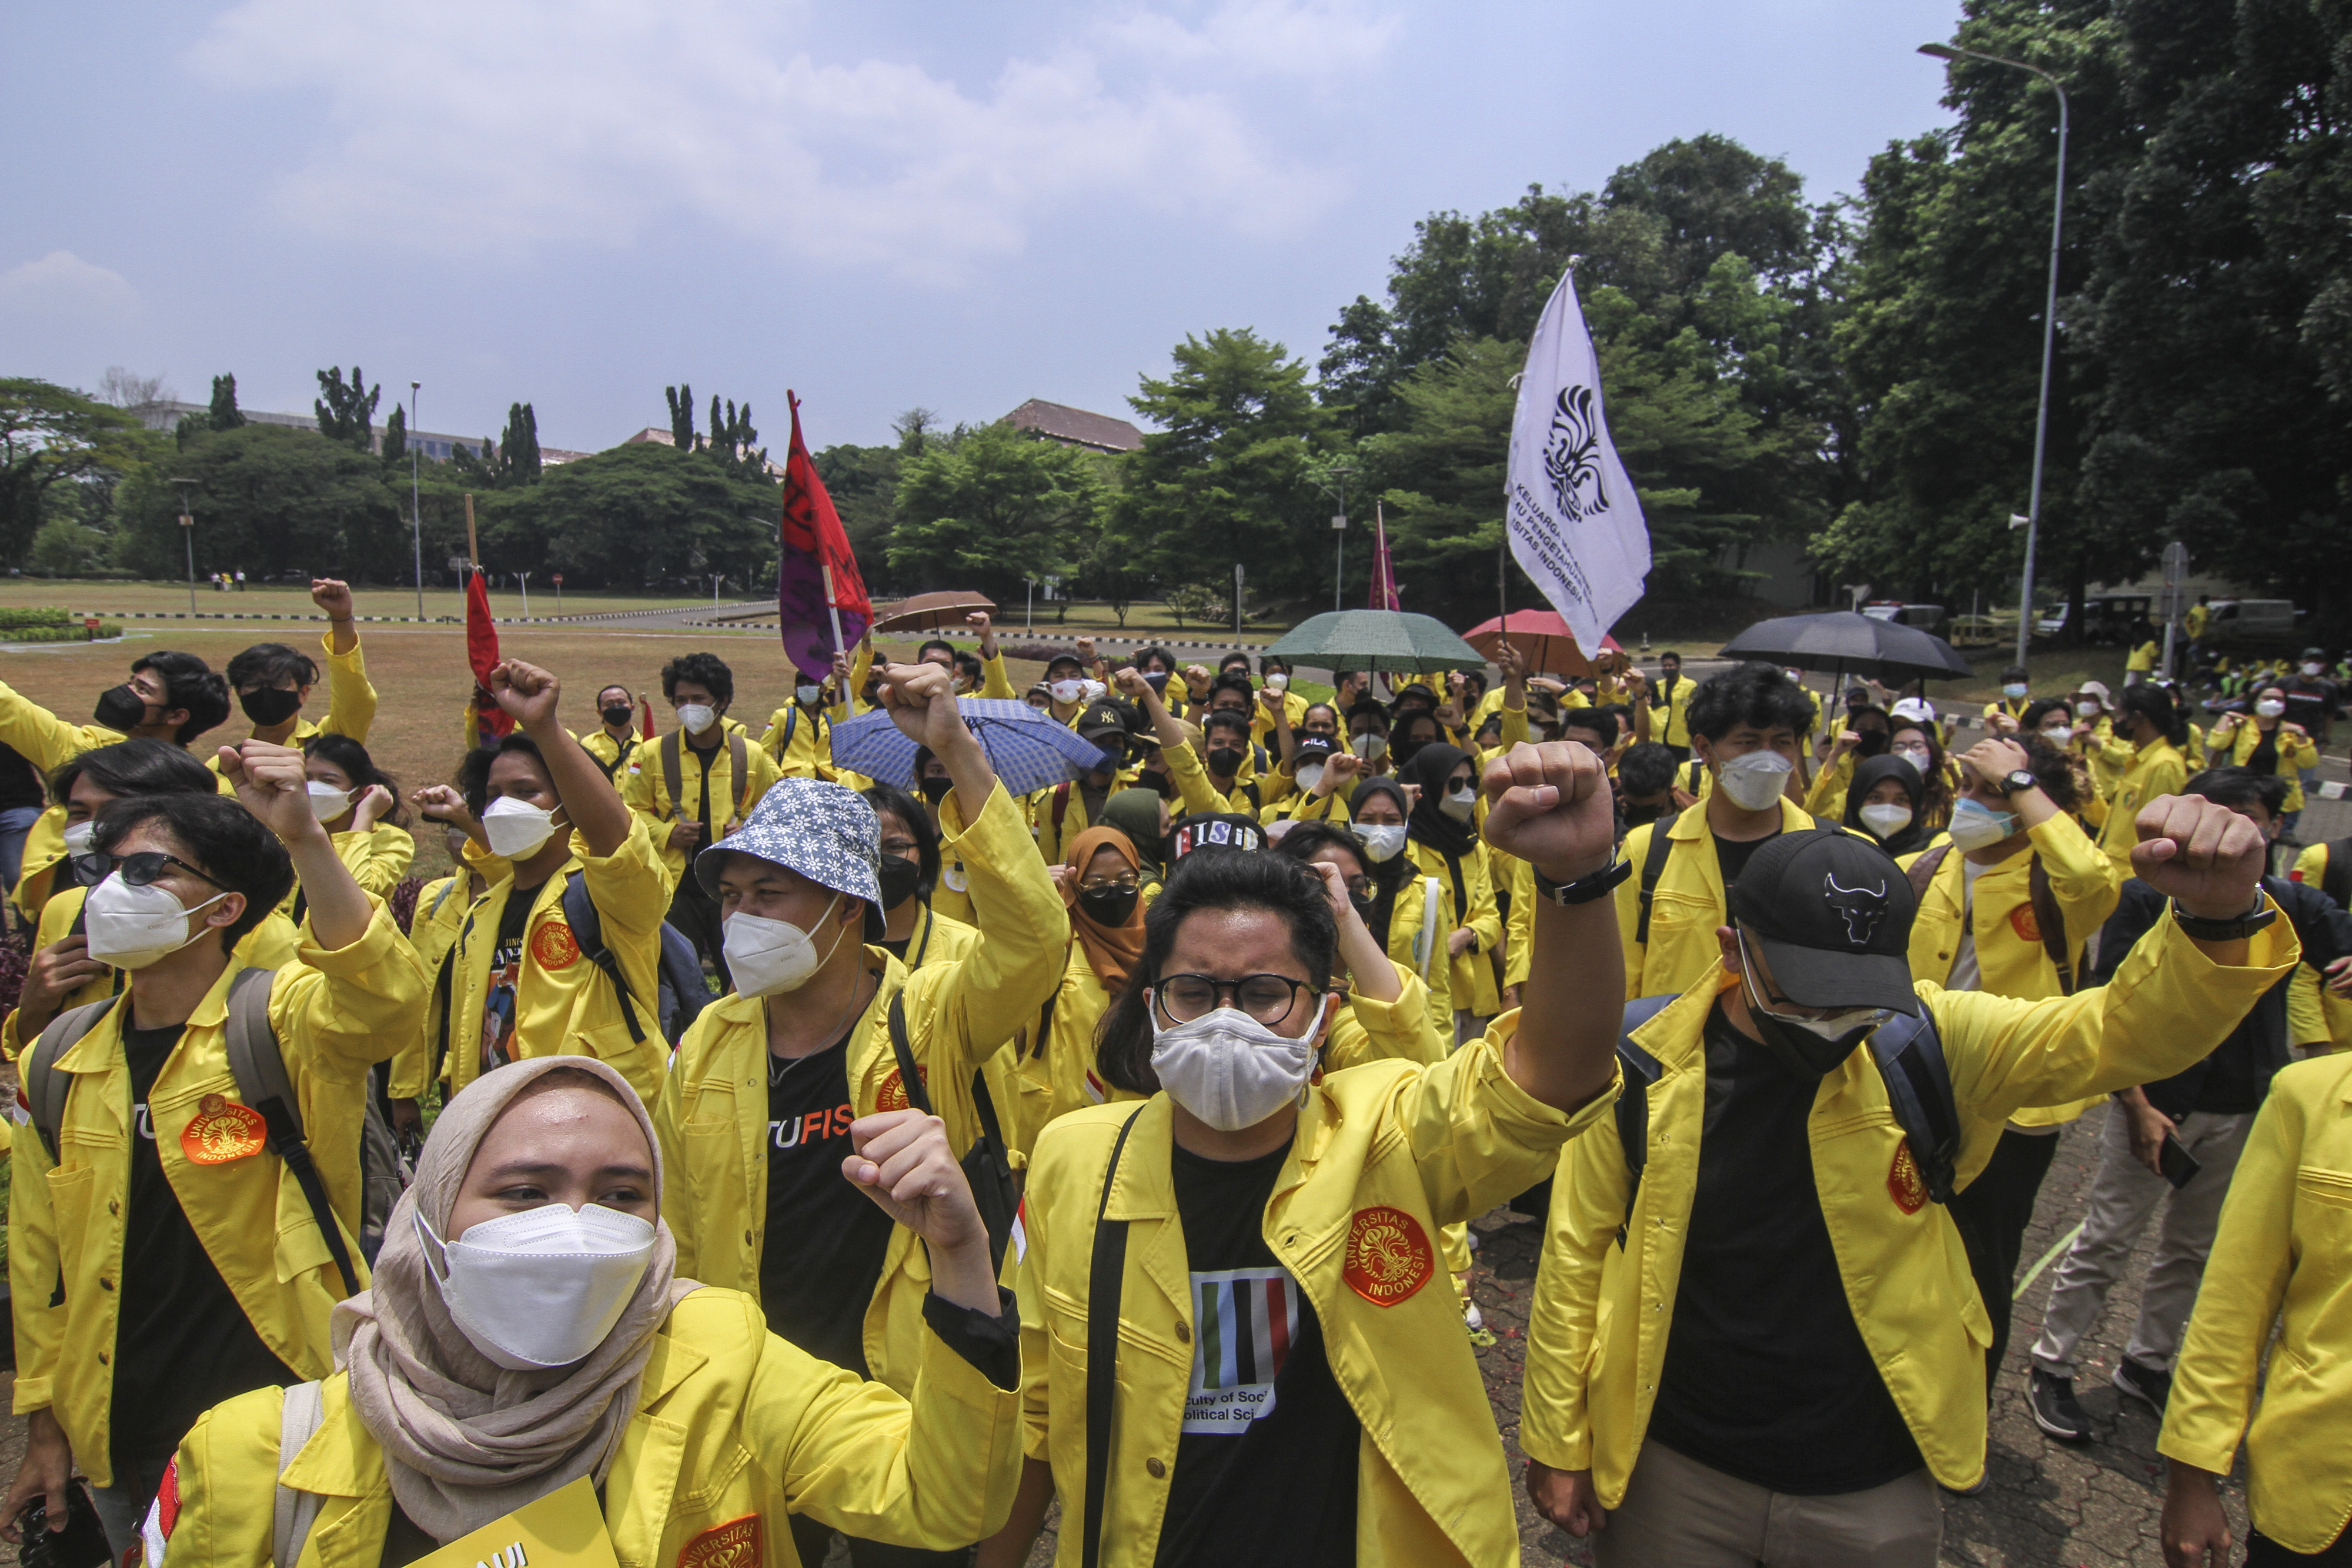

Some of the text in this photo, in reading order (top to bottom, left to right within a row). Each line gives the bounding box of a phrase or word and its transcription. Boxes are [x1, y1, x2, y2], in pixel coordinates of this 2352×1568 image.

[1526, 516, 1582, 588] PENGETAHU
[1538, 550, 1583, 605] INDONESIA
[1302, 738, 1328, 748] FILA
[536, 924, 572, 947] UNIVERSITAS
[541, 947, 576, 966] INDONESIA
[189, 1106, 258, 1138] UNIVSITAS
[196, 1139, 260, 1161] INDONESIA
[1347, 1212, 1408, 1269] UNIVERSITAS
[1368, 1248, 1425, 1296] INDONESIA
[1220, 1392, 1234, 1403] of
[1184, 1408, 1229, 1420] olitical
